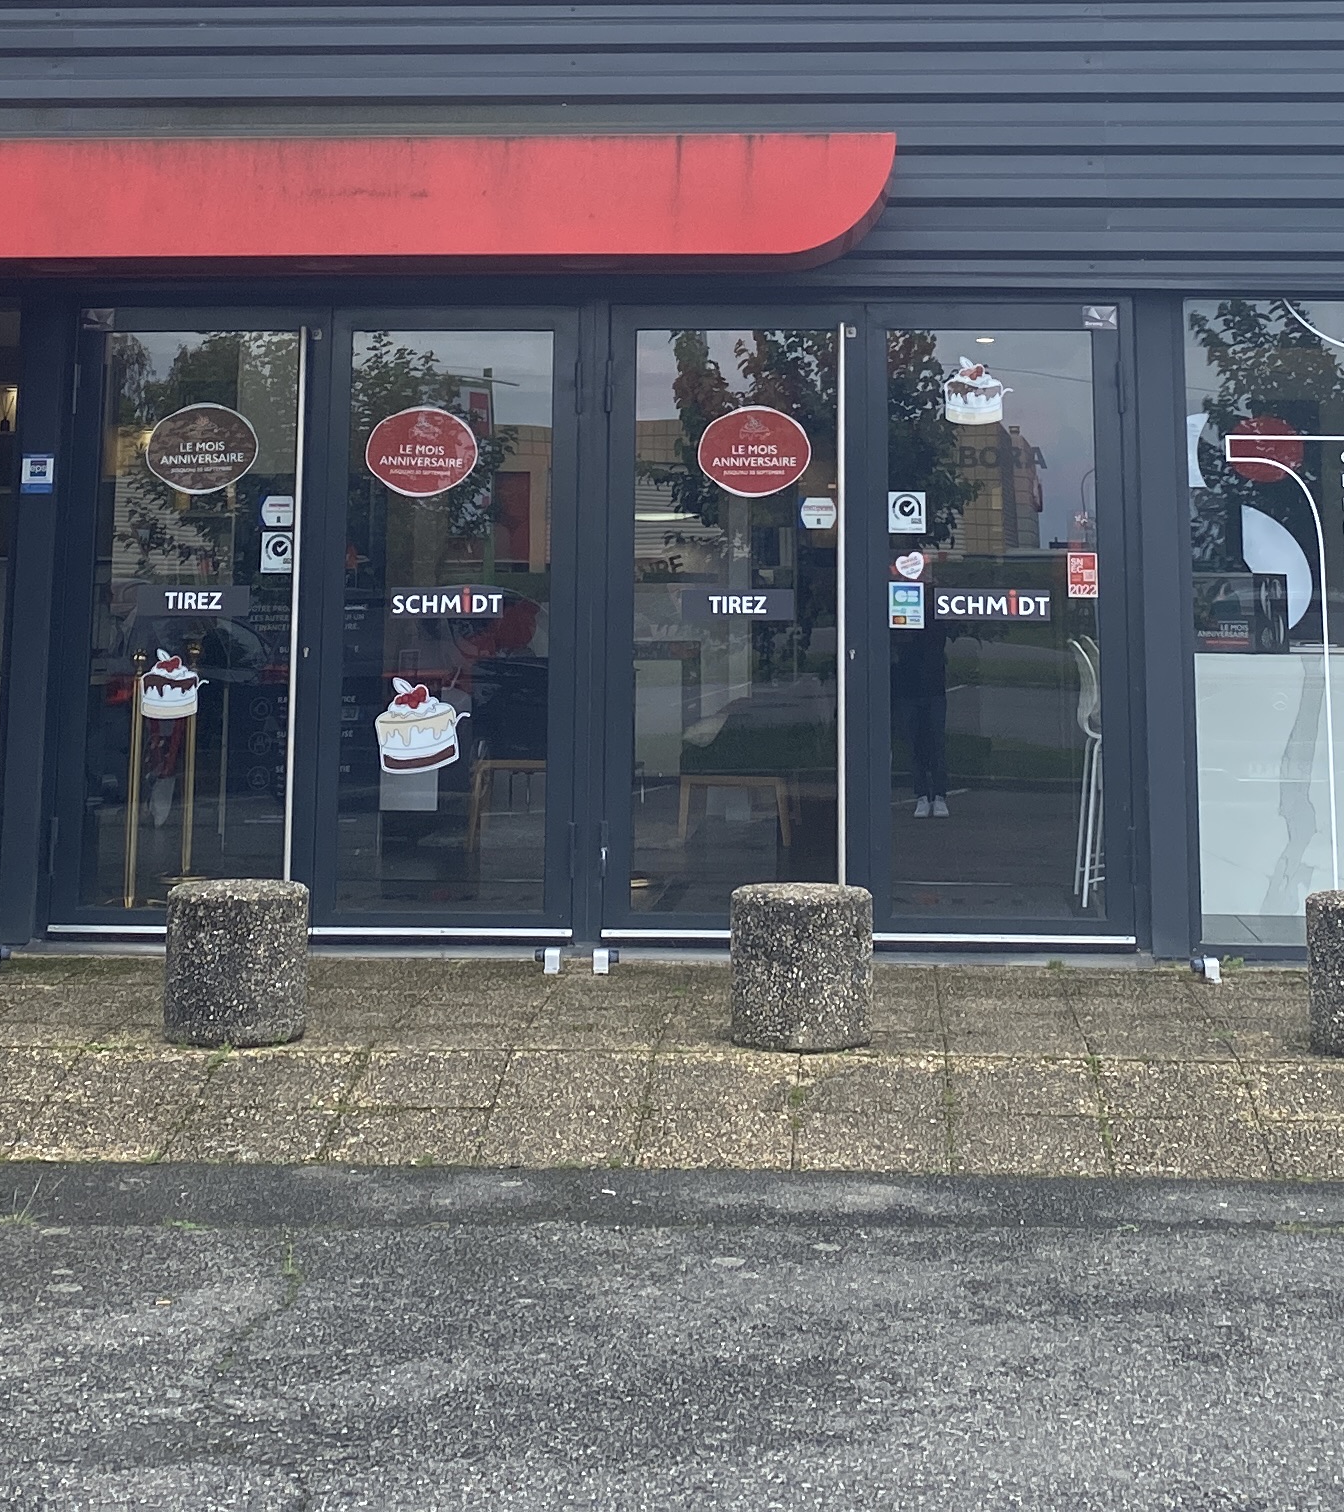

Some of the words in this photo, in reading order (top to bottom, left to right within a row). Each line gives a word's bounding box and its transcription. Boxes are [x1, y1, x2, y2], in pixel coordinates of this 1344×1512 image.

[179, 442, 193, 453] LE
[196, 441, 226, 452] MOIS
[399, 444, 413, 455] LE
[415, 445, 445, 456] MOIS
[731, 445, 745, 455] LE
[748, 445, 778, 455] MOIS
[160, 452, 244, 465] ANNIVERSAIRE
[379, 456, 463, 468] ANNIVERSAIRE
[712, 456, 797, 467] ANNIVERSAIRE
[1069, 584, 1097, 595] 2022
[164, 591, 223, 610] TIREZ
[708, 596, 767, 614] TIREZ
